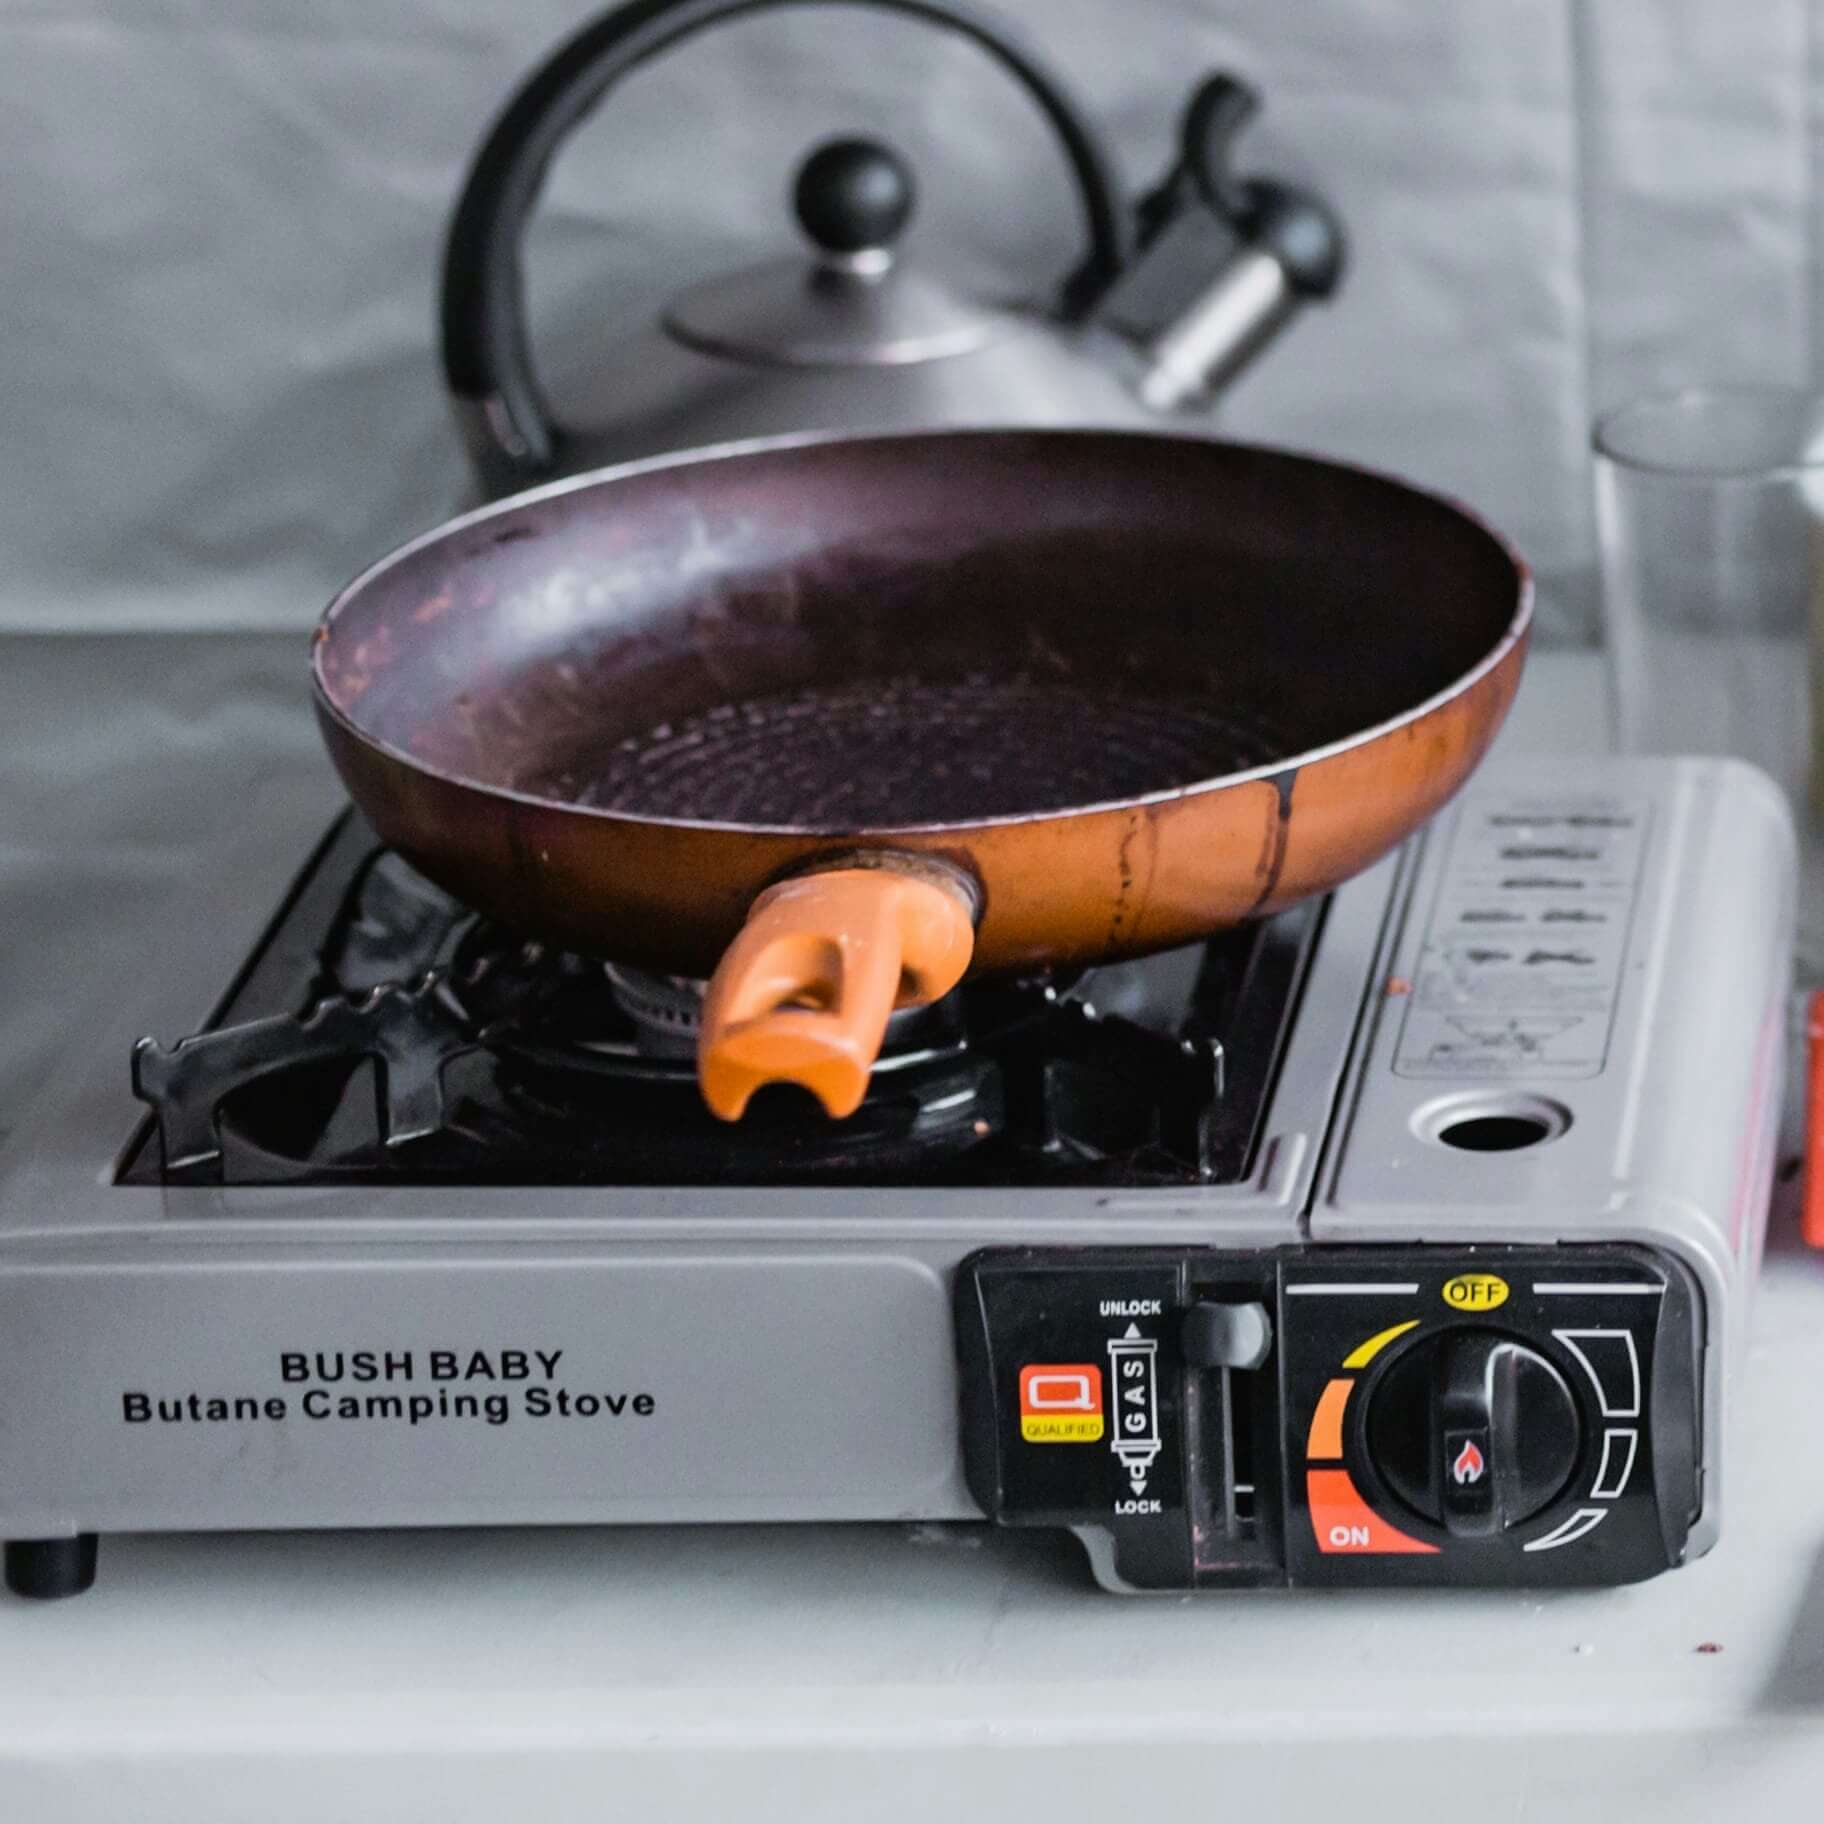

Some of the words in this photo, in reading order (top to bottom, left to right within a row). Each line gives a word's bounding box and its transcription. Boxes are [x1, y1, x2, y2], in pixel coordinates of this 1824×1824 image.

[1447, 1281, 1503, 1303] OFF
[1099, 1299, 1162, 1316] UNLOCK
[280, 1351, 413, 1383] BUSH
[429, 1349, 564, 1381] BABY
[122, 1391, 288, 1423] Butane
[302, 1388, 510, 1425] Camping
[524, 1386, 657, 1419] Stove
[1123, 1359, 1147, 1433] GAS
[1026, 1422, 1101, 1437] QUALIFIED
[1115, 1500, 1162, 1514] LOCK
[1329, 1527, 1370, 1546] ON
